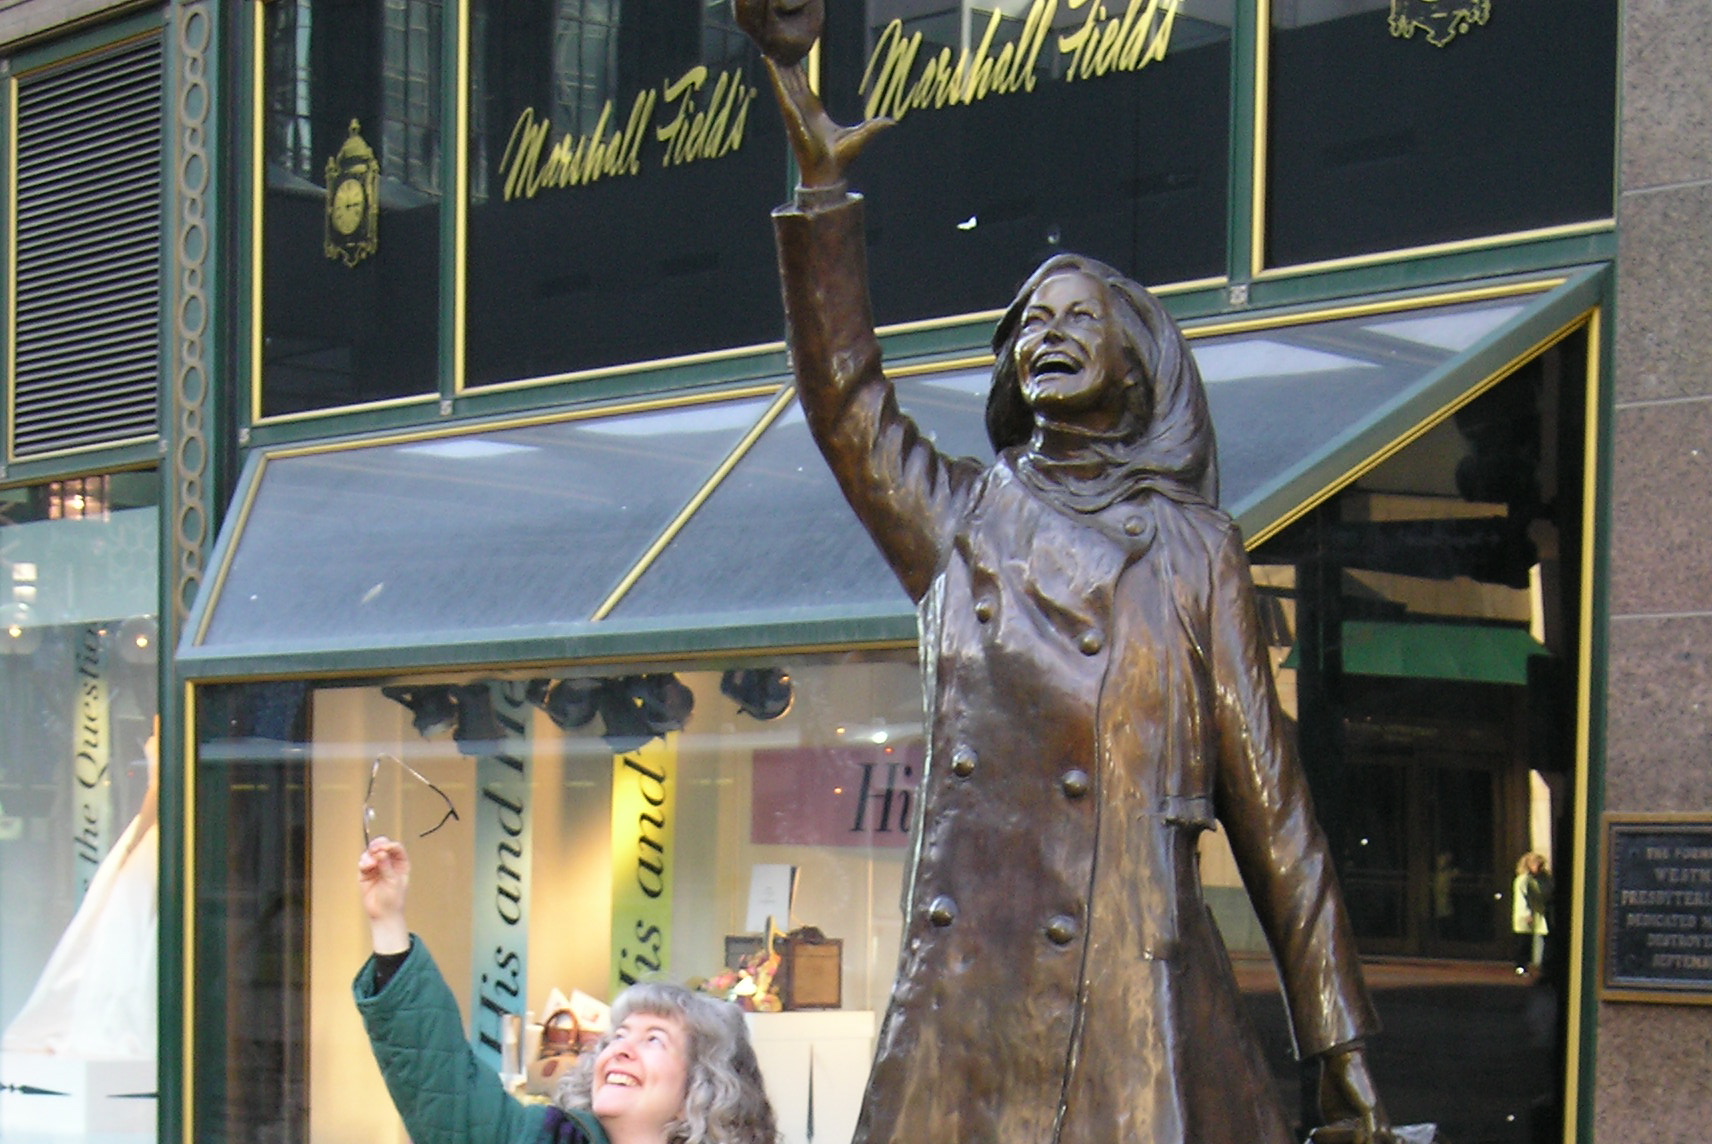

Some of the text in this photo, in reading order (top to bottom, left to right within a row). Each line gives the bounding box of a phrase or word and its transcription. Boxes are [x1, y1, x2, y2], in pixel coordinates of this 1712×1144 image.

[858, 0, 1178, 121] Marshall Fields
[499, 65, 758, 201] Marshall Field's
[73, 803, 100, 866] the
[483, 786, 523, 926] and
[618, 756, 666, 986] is and
